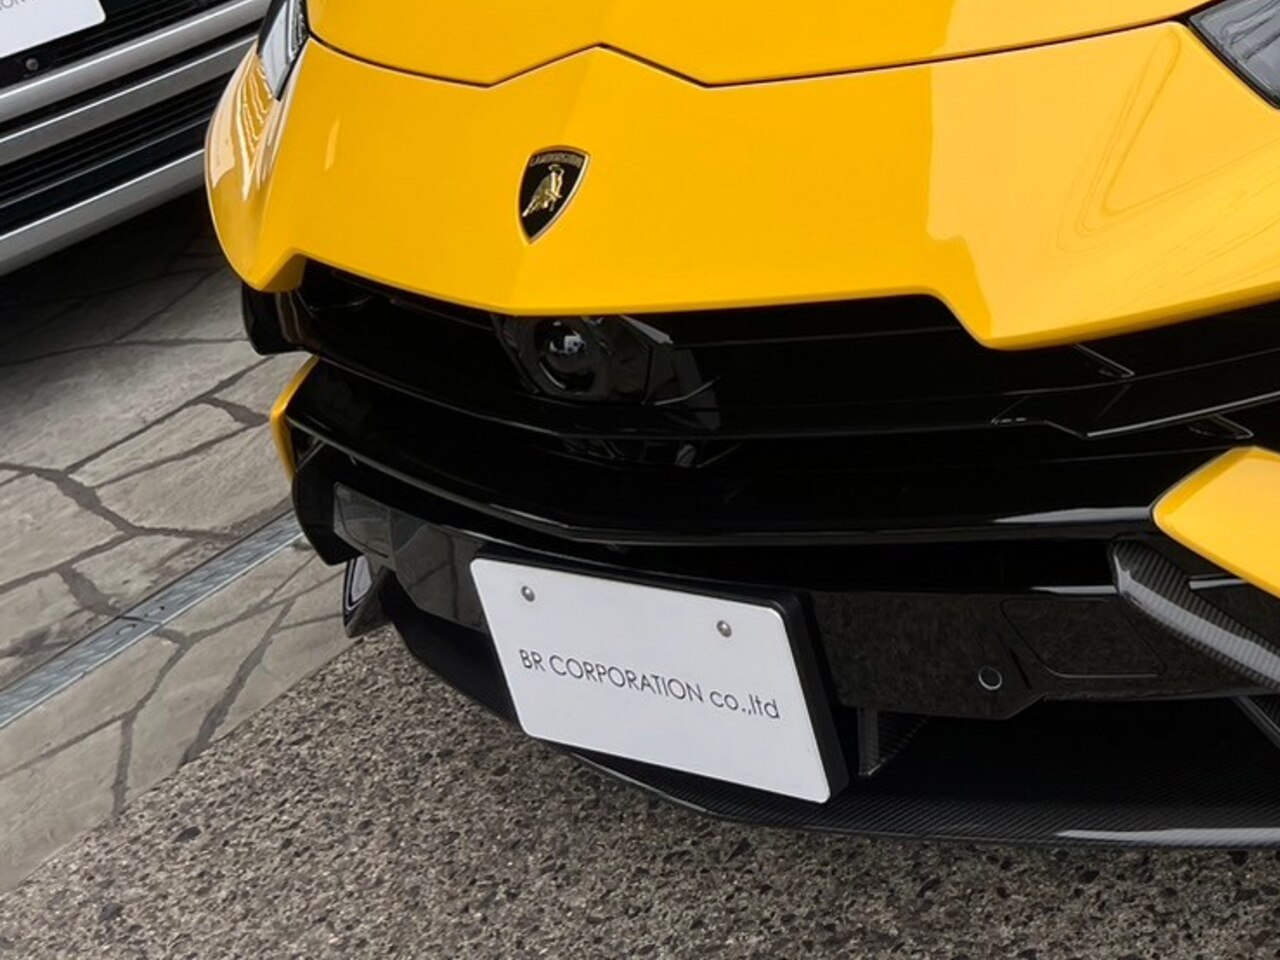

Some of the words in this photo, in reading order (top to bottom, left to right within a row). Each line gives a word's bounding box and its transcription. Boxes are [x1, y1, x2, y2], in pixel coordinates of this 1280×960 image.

[519, 649, 545, 671] BR
[549, 654, 704, 703] CORPORATION
[709, 692, 781, 720] co.,ltd
